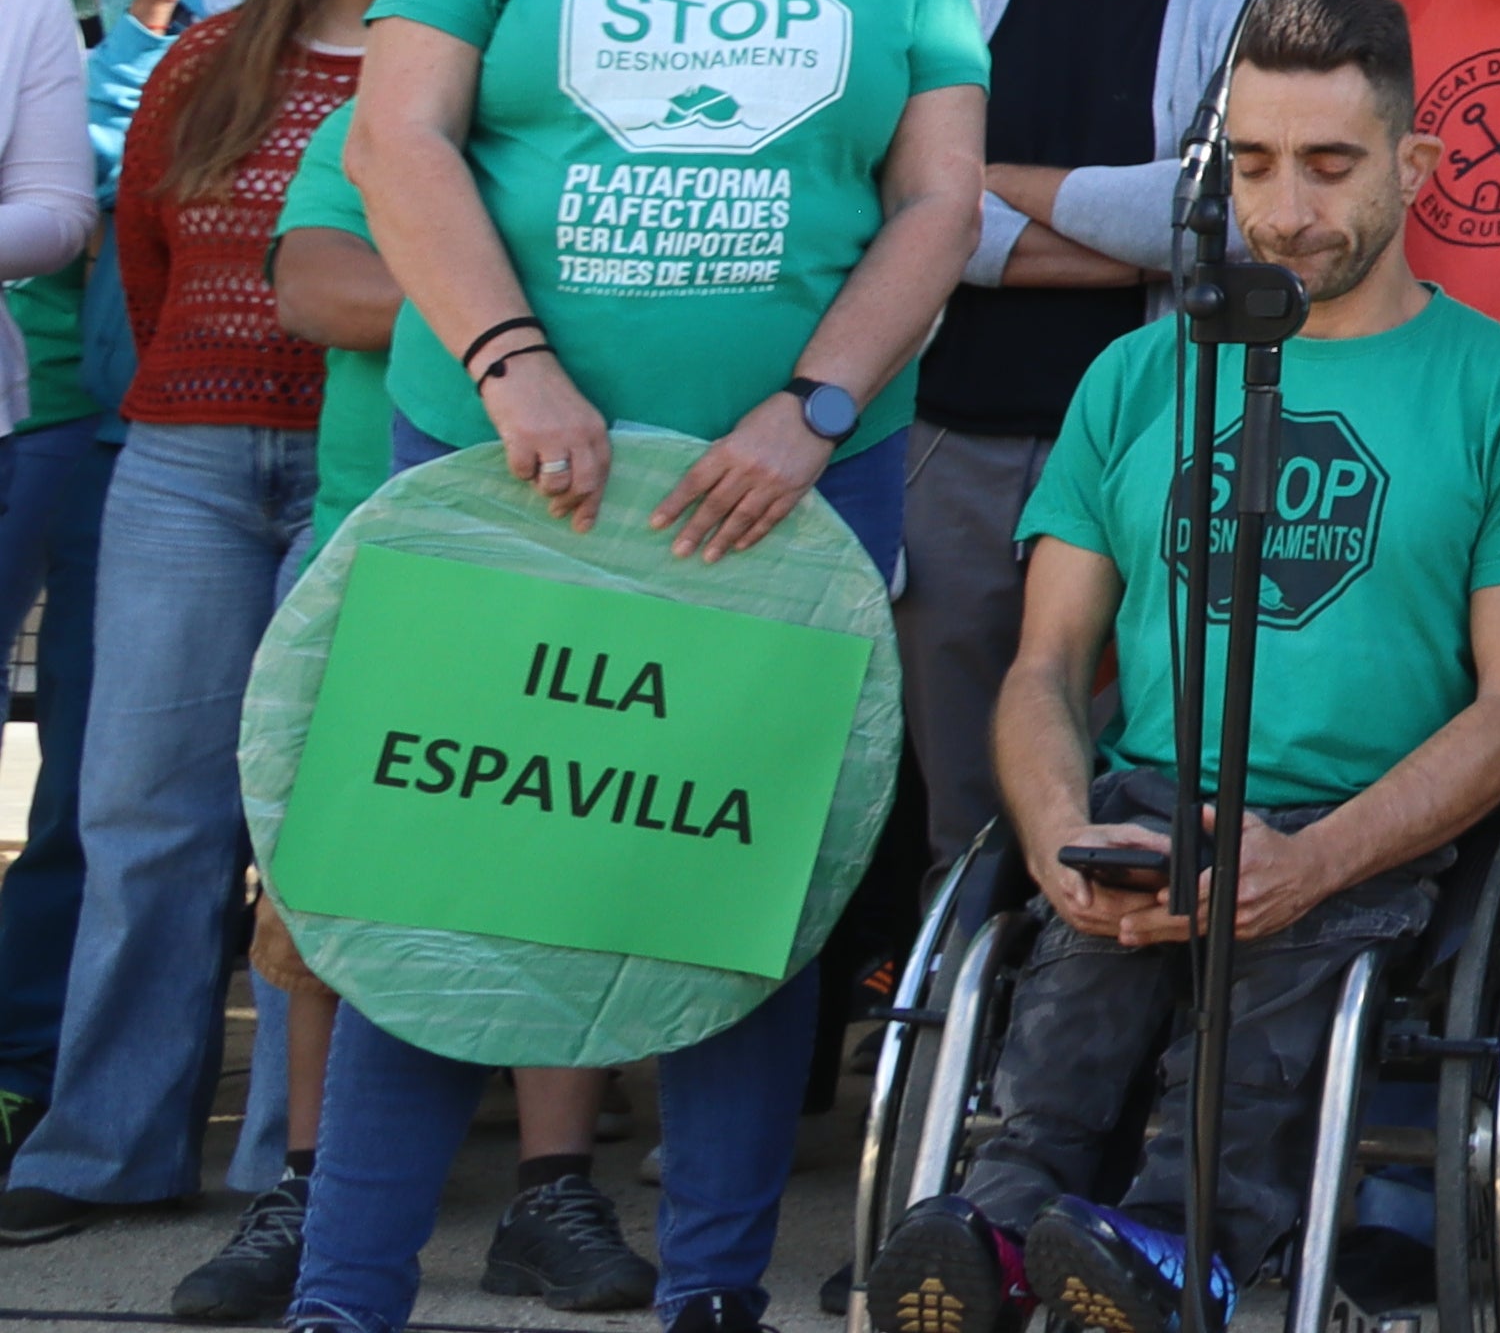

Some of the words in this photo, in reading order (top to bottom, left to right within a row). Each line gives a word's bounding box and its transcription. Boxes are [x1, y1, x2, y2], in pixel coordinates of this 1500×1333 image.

[596, 47, 819, 71] DESNONAMENTS
[563, 164, 791, 198] PLATAFORMA
[557, 193, 790, 229] D'AFECTADES
[1421, 193, 1452, 229] ENS
[556, 225, 611, 252] PER
[611, 229, 649, 255] LA
[653, 231, 785, 257] HIPOTECA
[557, 255, 655, 285] TERRES
[655, 261, 693, 286] DE
[694, 259, 781, 285] L'EBRE
[524, 643, 667, 718] ILLA
[373, 731, 753, 844] ESPAVILLA
